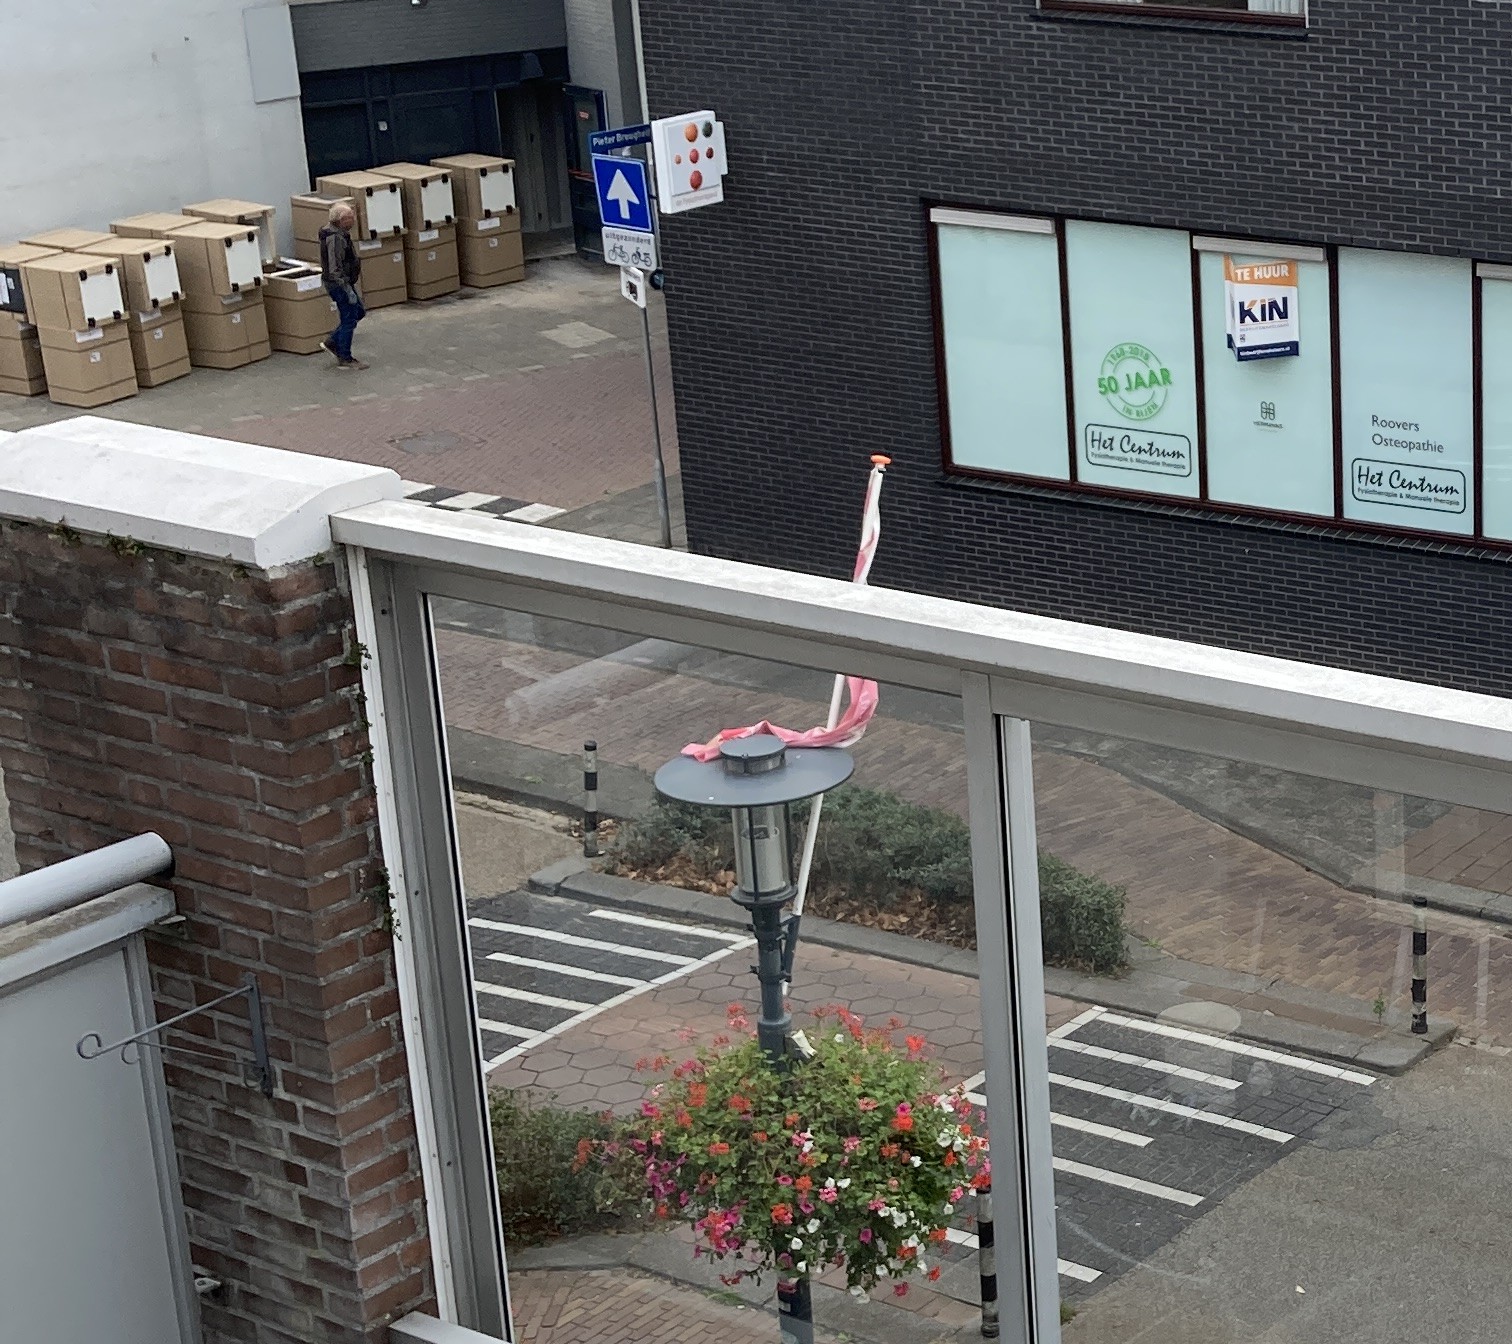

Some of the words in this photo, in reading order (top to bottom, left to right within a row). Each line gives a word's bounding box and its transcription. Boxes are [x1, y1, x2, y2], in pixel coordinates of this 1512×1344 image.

[592, 135, 615, 147] Pieter
[1235, 267, 1251, 281] TE
[1253, 264, 1290, 280] HUUR
[1097, 375, 1119, 395] 50
[1125, 367, 1173, 392] JAAR
[1371, 414, 1420, 432] Roovers
[1090, 430, 1115, 452] Het
[1120, 434, 1185, 459] Centrum
[1371, 433, 1445, 454] Osteopathie
[1357, 465, 1384, 487] Het
[1388, 469, 1460, 495] Centrum
